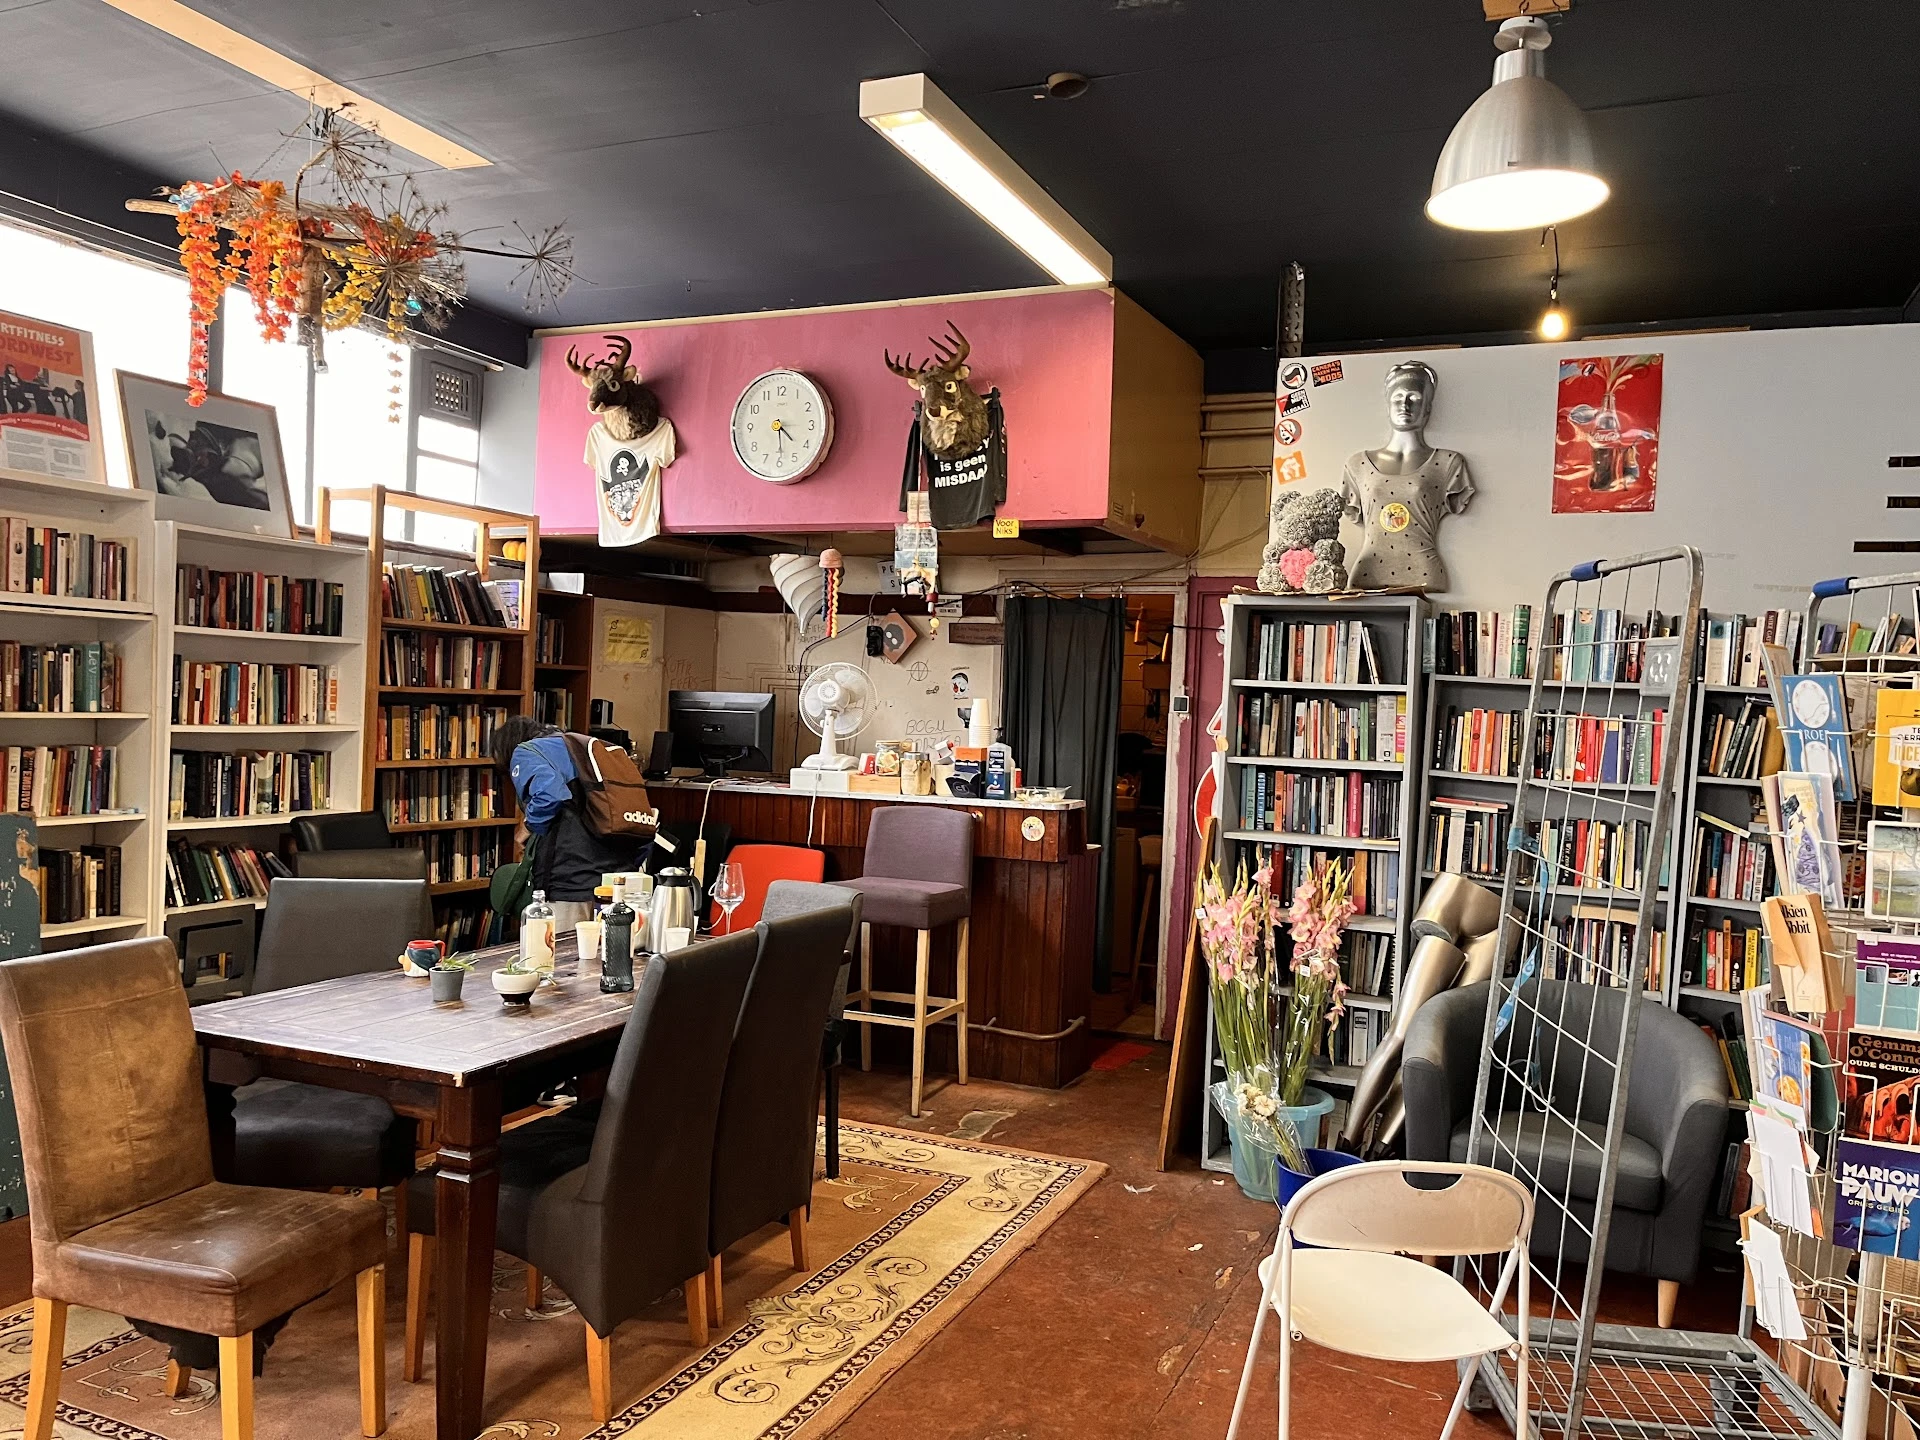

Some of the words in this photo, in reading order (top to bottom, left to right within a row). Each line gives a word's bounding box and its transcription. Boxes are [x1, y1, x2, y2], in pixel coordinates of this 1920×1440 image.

[762, 390, 771, 401] 11
[776, 385, 787, 397] 12
[749, 404, 760, 415] 10
[804, 401, 812, 413] 2
[746, 422, 754, 434] 9
[808, 419, 815, 431] 3
[750, 441, 758, 452] 8
[802, 439, 810, 449] 4
[762, 453, 769, 464] 7
[775, 456, 783, 468] 6
[791, 452, 798, 463] 5
[939, 461, 952, 472] is
[955, 454, 987, 472] geen
[995, 519, 1014, 528] Voor
[995, 526, 1013, 535] Niks
[88, 650, 100, 674] Lev
[623, 810, 658, 826] adidas
[1849, 1059, 1877, 1068] OUDE
[1842, 1161, 1920, 1188] MARION
[1841, 1175, 1920, 1208] PAUW
